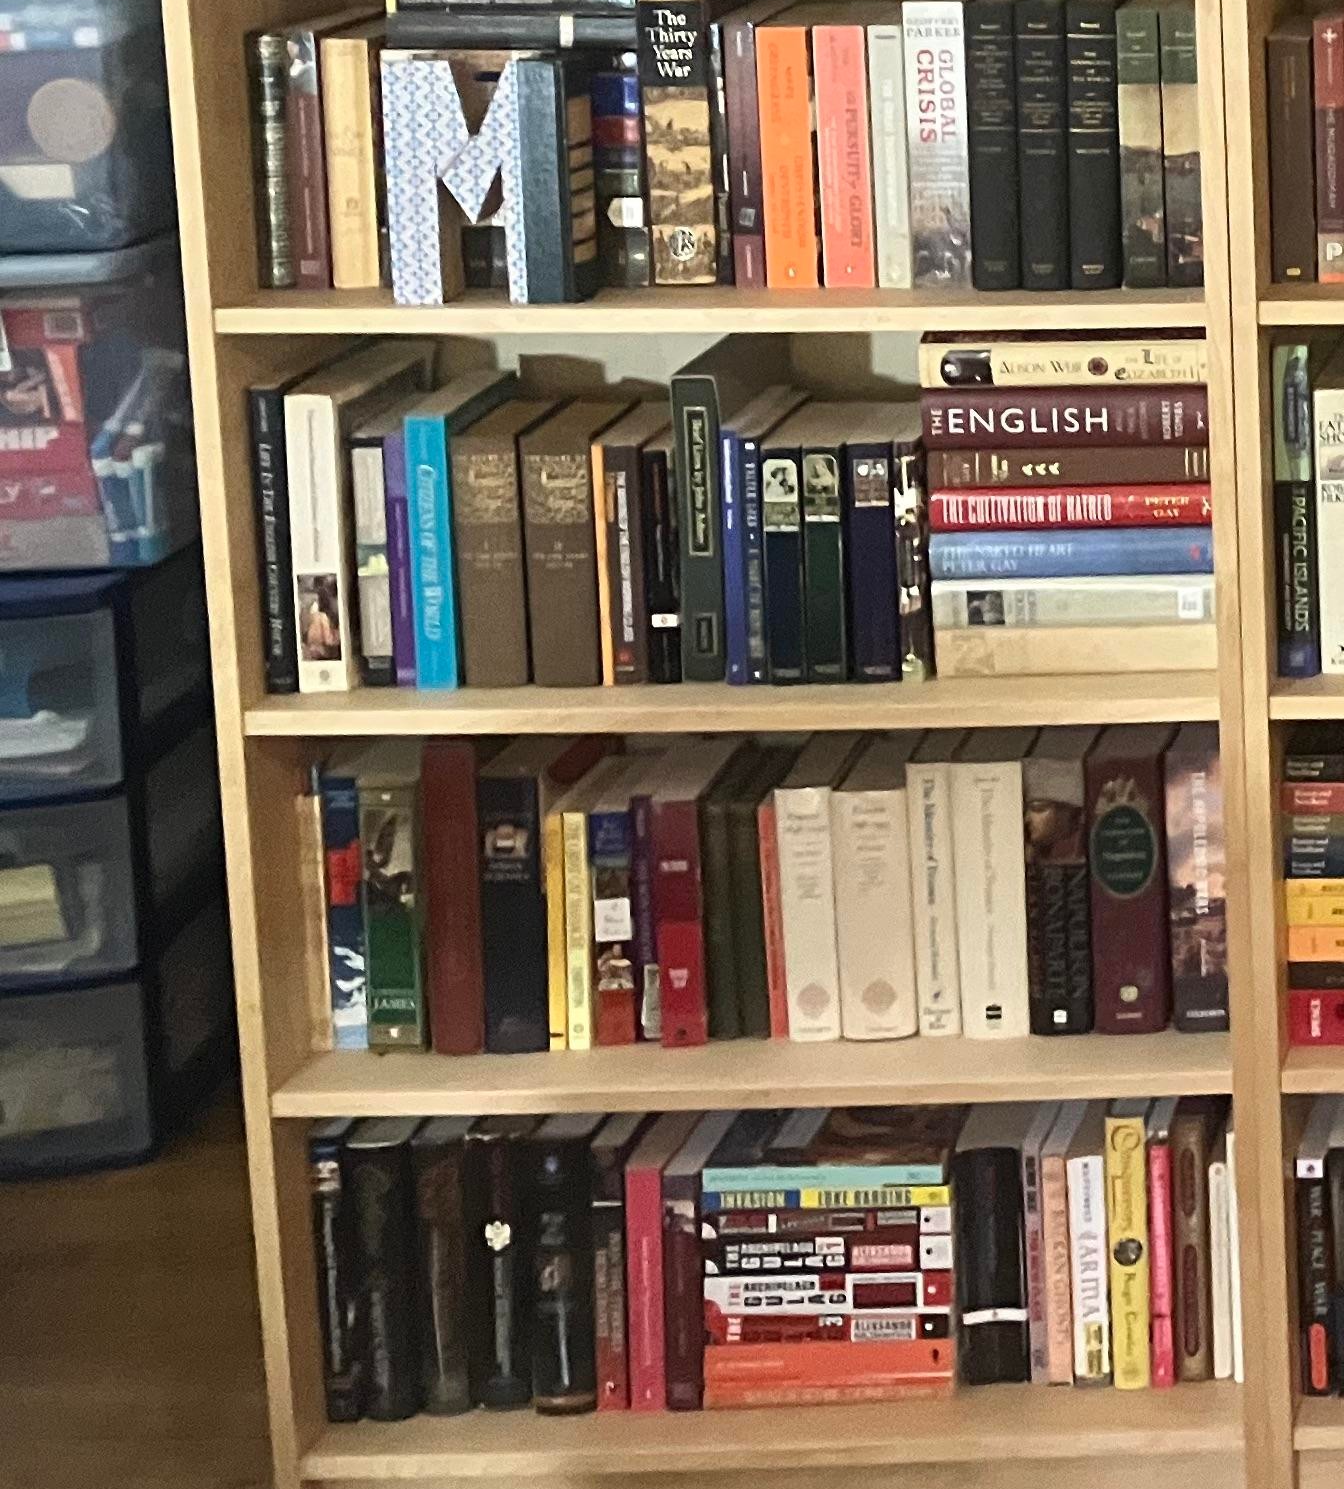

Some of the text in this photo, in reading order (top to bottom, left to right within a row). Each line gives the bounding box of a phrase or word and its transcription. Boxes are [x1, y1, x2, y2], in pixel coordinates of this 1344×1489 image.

[653, 9, 686, 27] The
[645, 28, 697, 47] Thirty
[653, 45, 694, 62] Years
[656, 61, 692, 78] War
[916, 49, 937, 144] CRISIS
[937, 49, 957, 144] GLOBAL
[931, 408, 942, 436] THE
[947, 407, 1109, 434] ENGLISH
